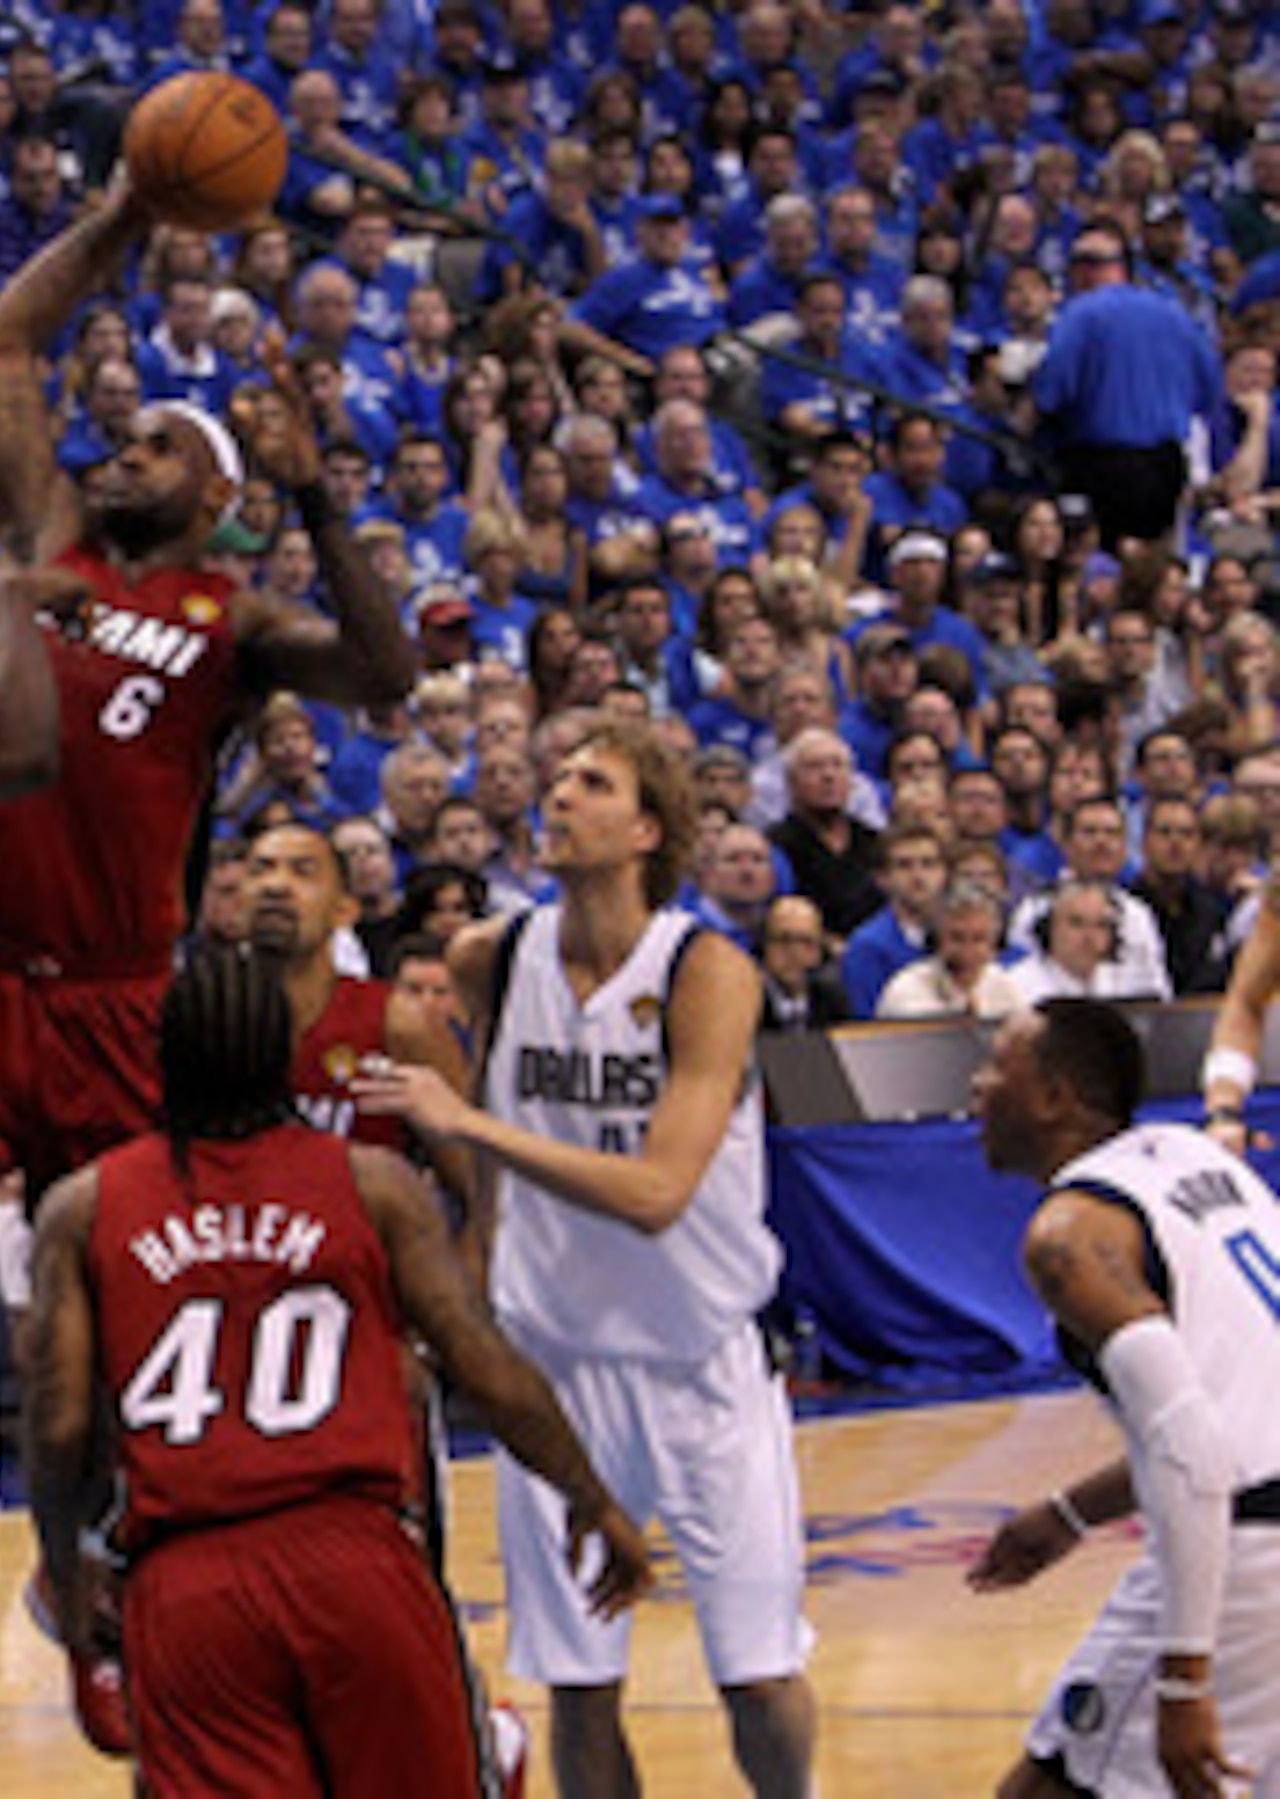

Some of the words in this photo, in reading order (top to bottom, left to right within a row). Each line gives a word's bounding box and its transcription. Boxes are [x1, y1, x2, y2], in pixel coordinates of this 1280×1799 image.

[98, 674, 165, 742] 6
[516, 1045, 663, 1110] DALLAS
[129, 1203, 327, 1284] HASLEM
[120, 1284, 352, 1444] 40
